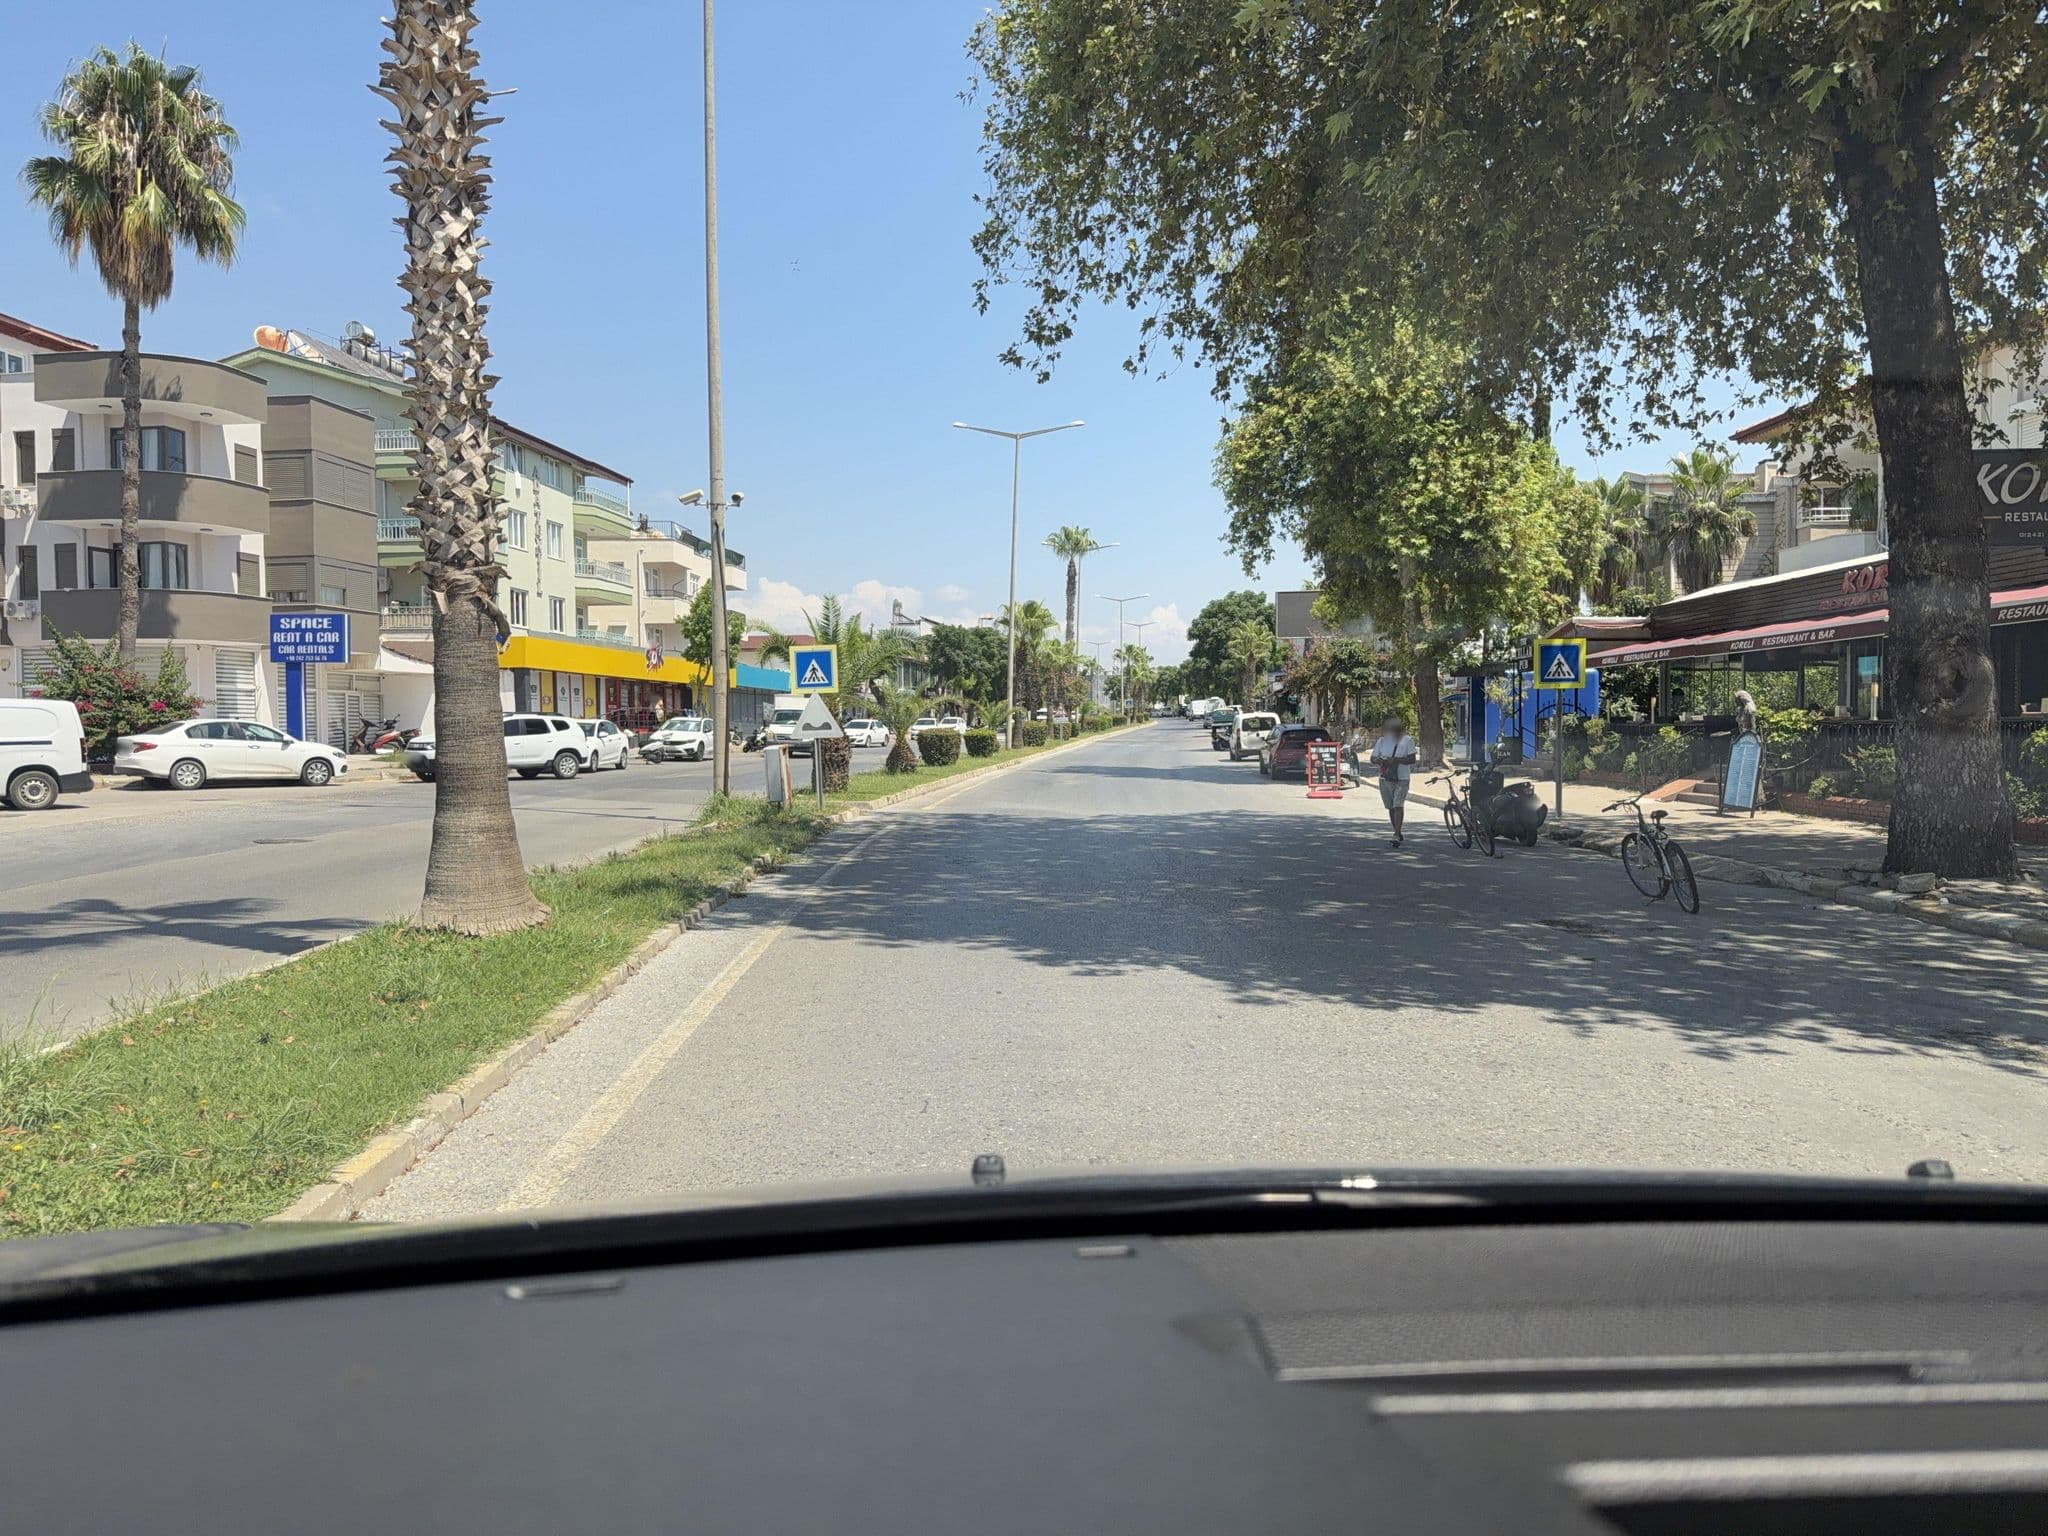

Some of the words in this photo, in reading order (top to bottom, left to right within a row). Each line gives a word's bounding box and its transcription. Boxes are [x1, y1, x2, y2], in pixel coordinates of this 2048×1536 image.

[1977, 462, 2048, 504] KO
[280, 617, 332, 629] SPACE
[273, 631, 301, 643] RENT
[305, 631, 313, 643] A
[316, 631, 340, 643] CAR
[1761, 632, 1809, 646] RESTAURANT
[1818, 629, 1836, 640] BAR
[278, 645, 295, 654] CAR
[297, 645, 335, 654] RENTALS
